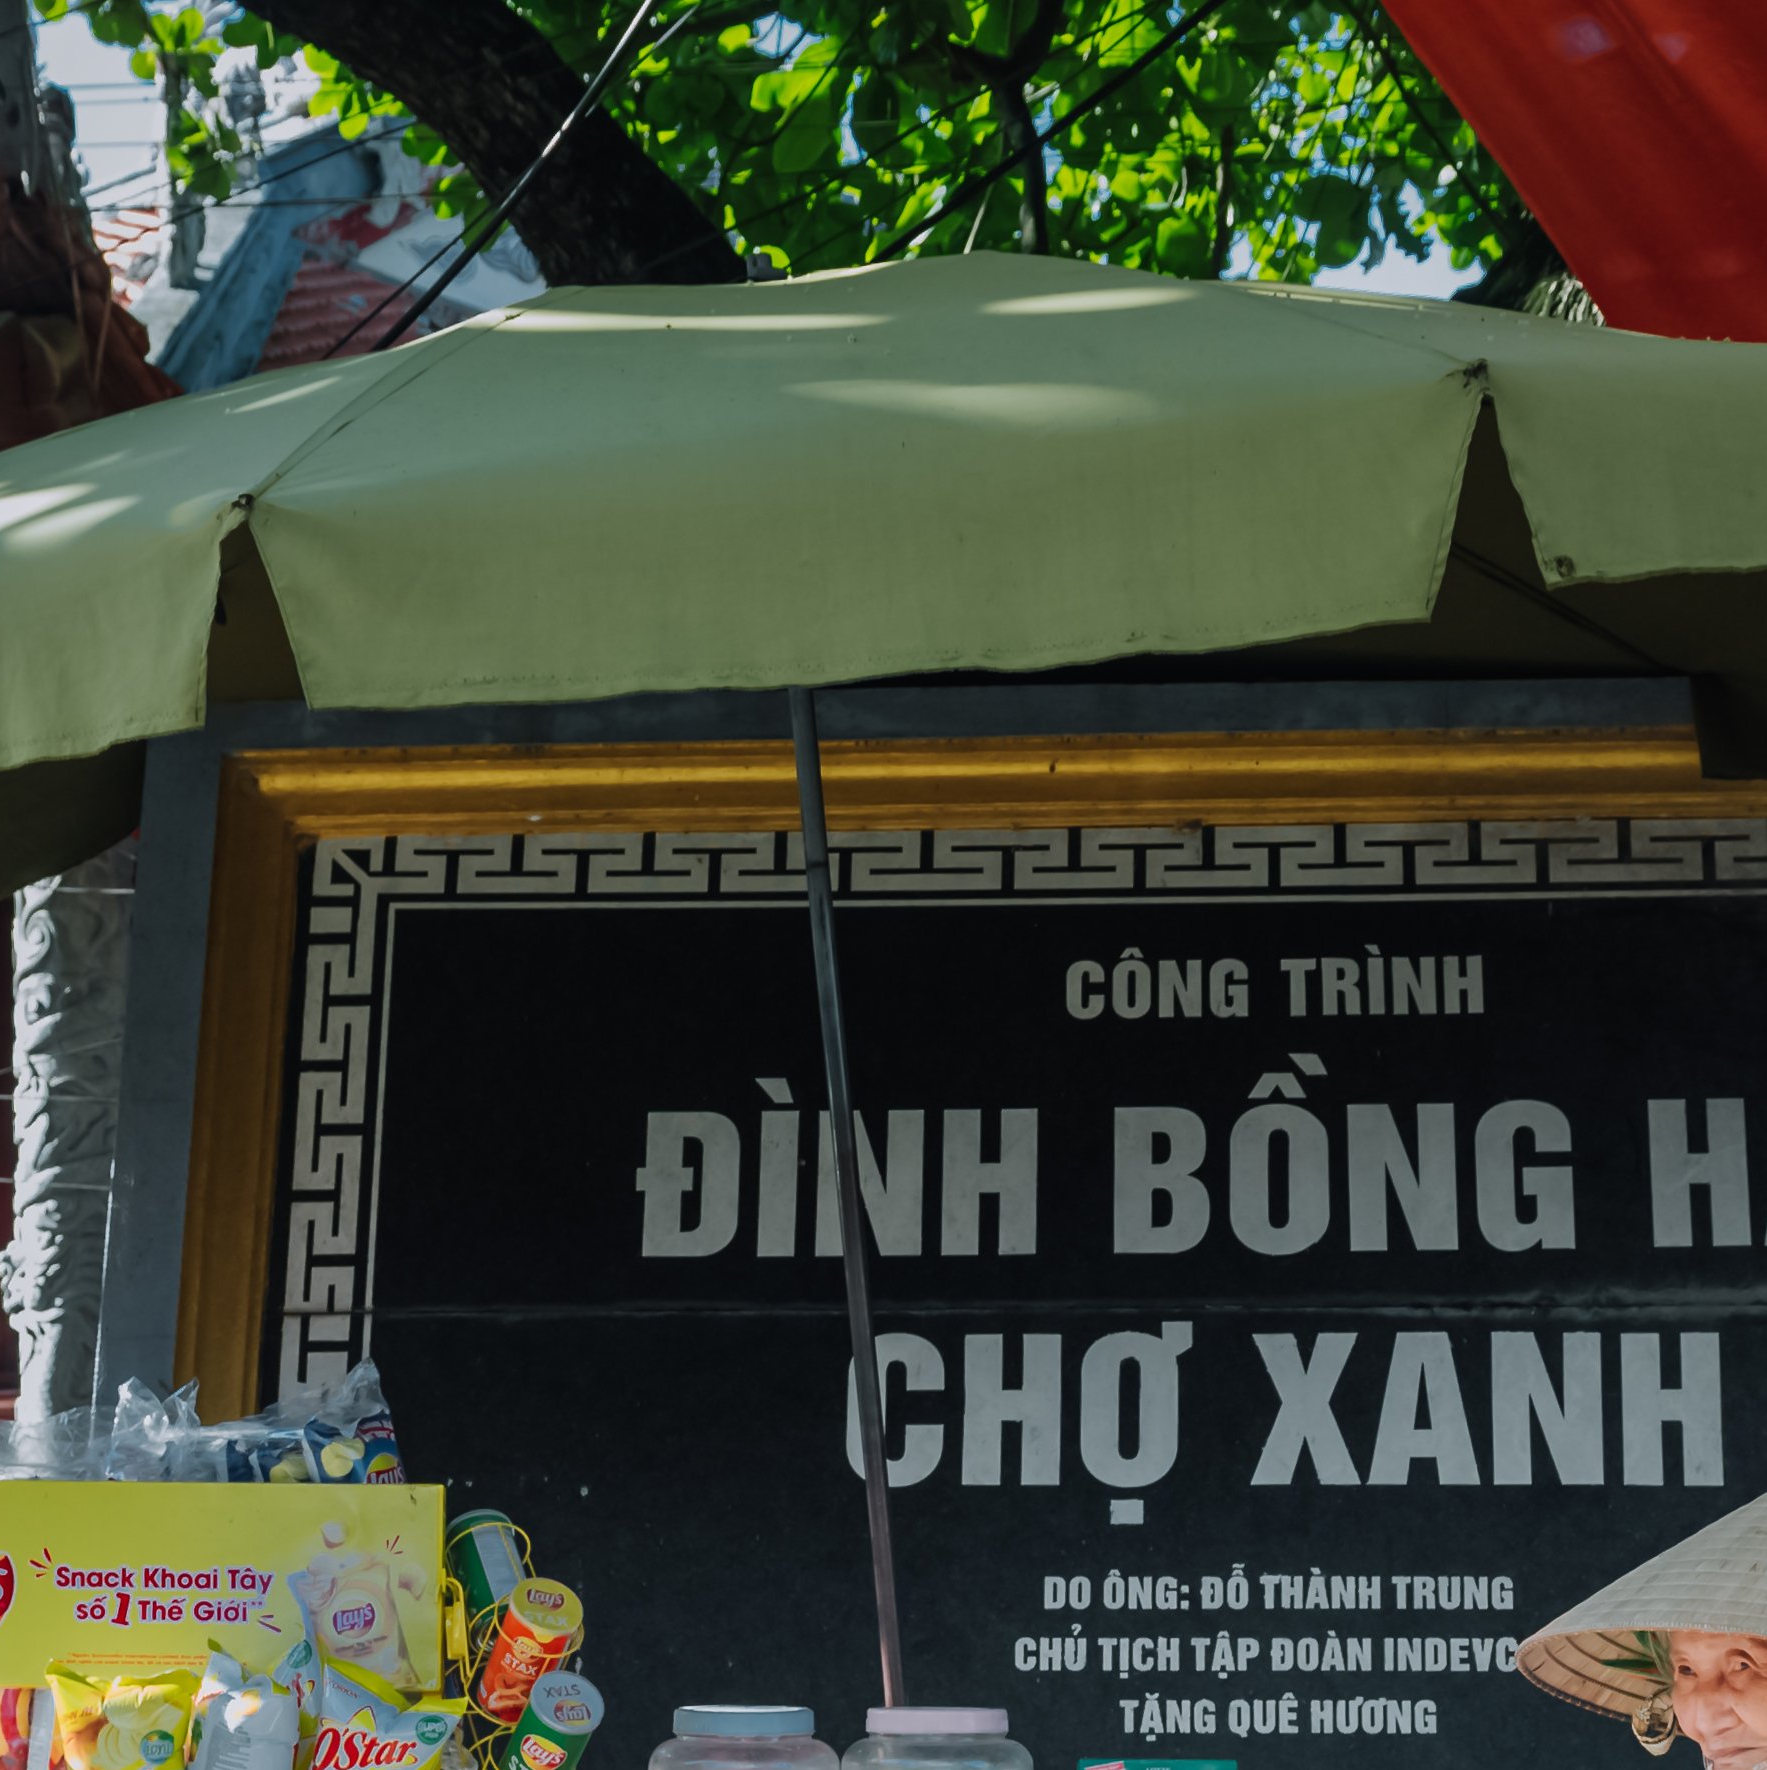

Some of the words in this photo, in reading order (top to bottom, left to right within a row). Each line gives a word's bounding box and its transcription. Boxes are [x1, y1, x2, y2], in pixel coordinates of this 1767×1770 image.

[1065, 947, 1250, 1020] CÔNG
[1280, 944, 1486, 1016] TRÌNH
[635, 1077, 1038, 1258] ĐÌNH
[1113, 1052, 1576, 1255] BỒNG
[844, 1321, 1192, 1525] CHỢ
[1249, 1330, 1725, 1487] XANH
[55, 1566, 135, 1590] Snack
[143, 1567, 219, 1591] Khoai
[227, 1568, 274, 1595] Tây
[526, 1587, 565, 1611] Lay's
[1043, 1576, 1091, 1610] DO
[1102, 1569, 1190, 1610] ÔNG:
[1199, 1563, 1249, 1610] ĐỖ
[1259, 1567, 1381, 1610] THÀNH
[1391, 1576, 1514, 1611] TRUNG
[75, 1598, 108, 1621] số
[111, 1592, 132, 1626] 1
[137, 1598, 185, 1622] Thế
[334, 1603, 375, 1632] Lay's
[502, 1652, 537, 1676] STAX
[1014, 1623, 1088, 1672] CHỦ
[1097, 1636, 1180, 1680] TỊCH
[1190, 1631, 1260, 1680] TẬP
[1270, 1630, 1375, 1672] ĐOÀN
[1119, 1692, 1216, 1742] TẶNG
[1227, 1692, 1298, 1738] QUÊ
[1310, 1697, 1438, 1735] HƯƠNG
[521, 1735, 567, 1766] Lay's
